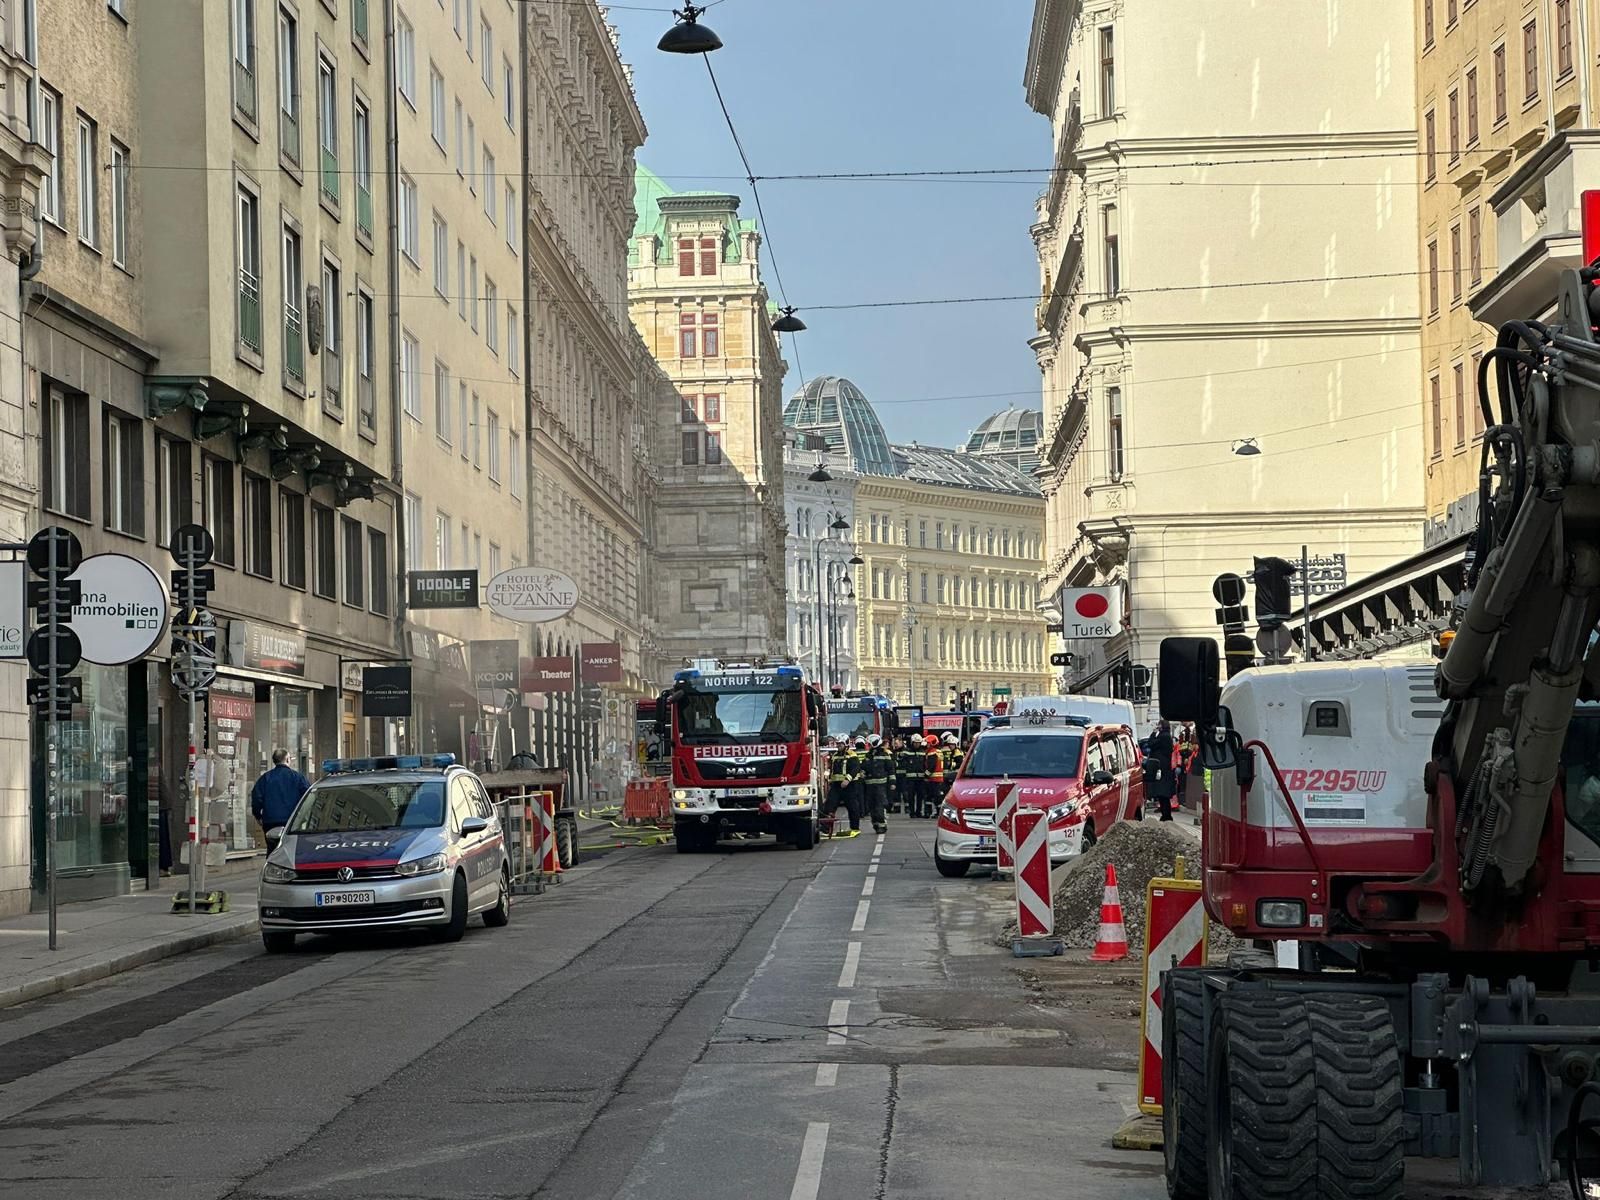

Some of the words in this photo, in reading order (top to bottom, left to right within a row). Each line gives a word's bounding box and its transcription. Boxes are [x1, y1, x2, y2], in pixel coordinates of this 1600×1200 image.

[416, 577, 471, 591] NOODLE
[507, 575, 542, 583] HOTEL
[495, 584, 543, 592] PENSION
[491, 592, 573, 606] SUZANNE
[1072, 623, 1112, 636] Turek
[540, 670, 571, 679] Theater
[705, 676, 750, 687] NOTRUF
[754, 675, 773, 685] 122
[693, 744, 788, 758] FEUERWEHR
[726, 767, 756, 775] MAN
[1063, 828, 1075, 838] 121
[315, 840, 389, 850] POLIZEI
